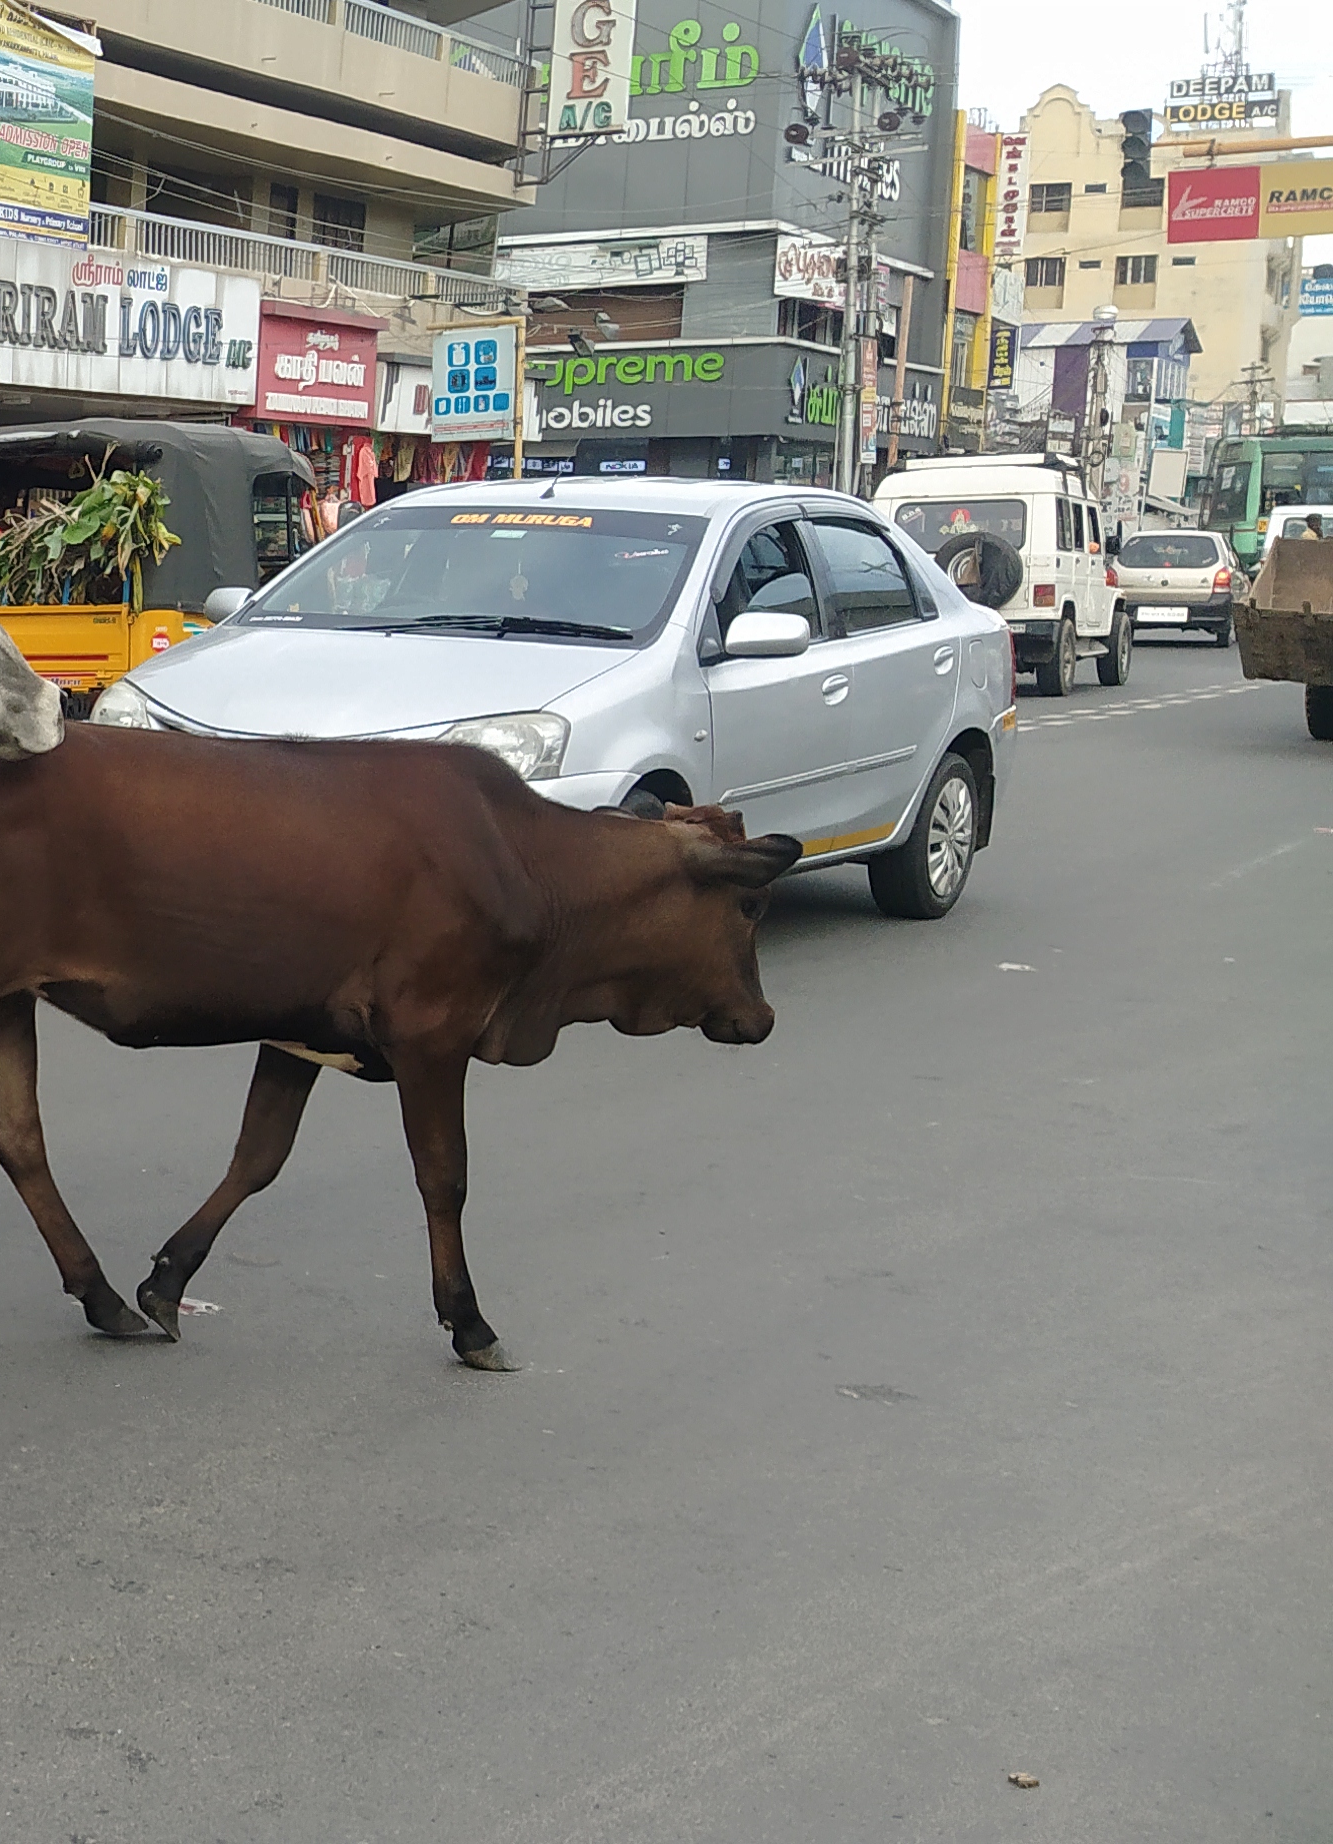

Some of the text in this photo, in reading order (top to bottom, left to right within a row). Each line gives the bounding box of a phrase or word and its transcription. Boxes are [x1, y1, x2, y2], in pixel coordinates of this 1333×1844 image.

[1172, 75, 1270, 97] DEEPAM
[1166, 102, 1246, 123] LODGE
[61, 137, 90, 159] OPEN
[1268, 187, 1333, 204] RAMC
[119, 296, 223, 366] LODGE
[541, 398, 653, 430] obiles
[450, 513, 593, 528] OM MURUGA
